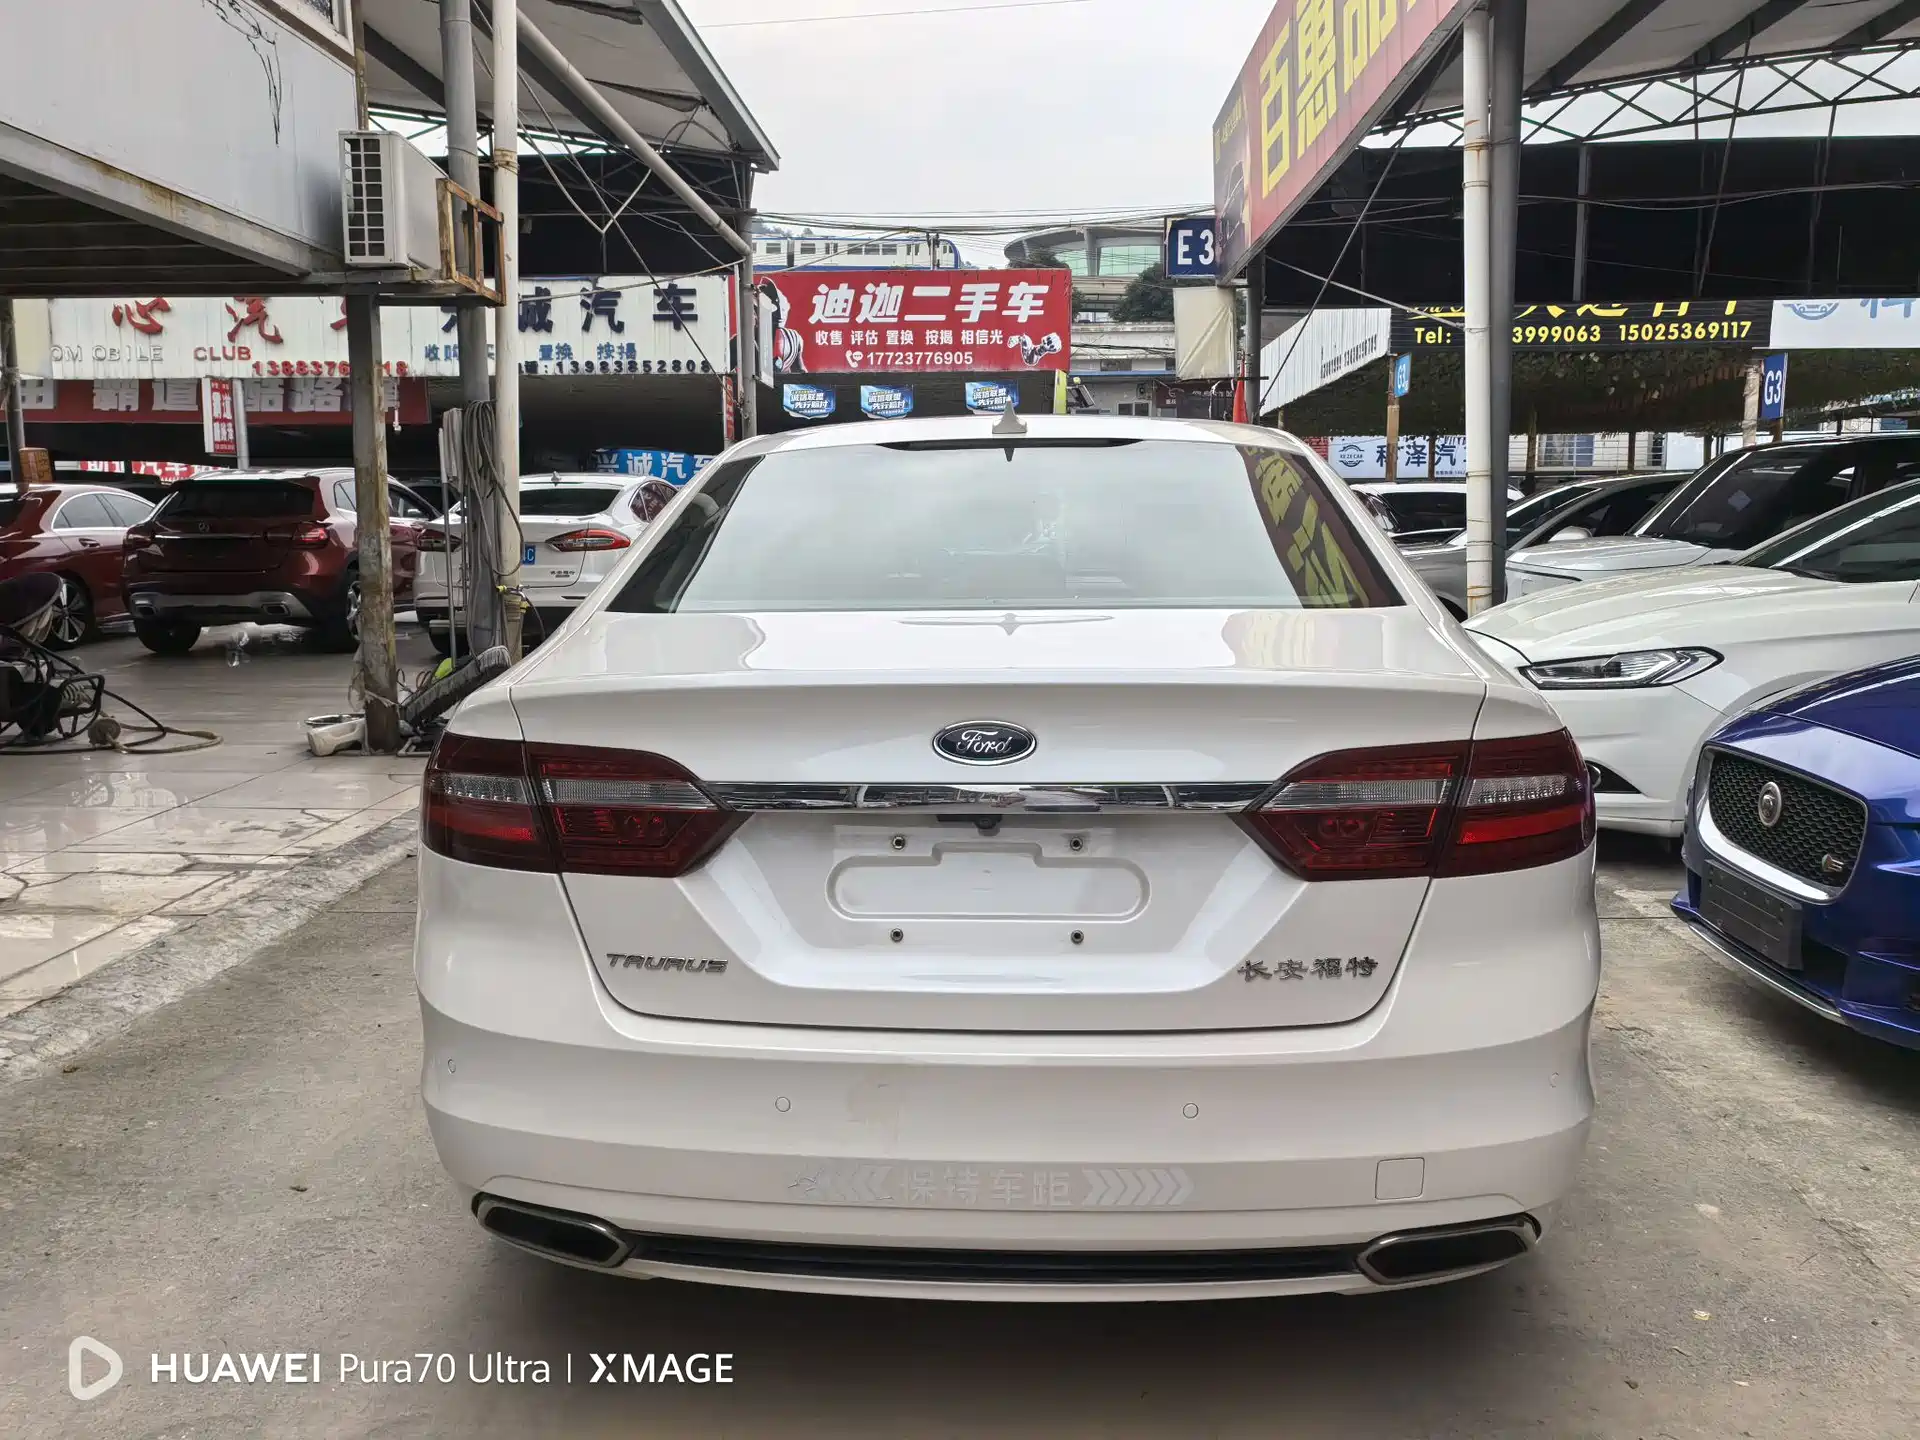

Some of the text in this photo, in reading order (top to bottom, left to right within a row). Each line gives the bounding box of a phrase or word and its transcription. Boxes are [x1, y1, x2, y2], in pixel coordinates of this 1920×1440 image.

[1177, 229, 1215, 266] E3
[808, 281, 1049, 324] 迪迦二手车
[815, 330, 1004, 346] 收售 评估 置换 按揭 相信光
[1414, 326, 1451, 344] Tel:
[1618, 321, 1752, 342] 15025369117
[194, 346, 252, 361] CLUB
[867, 351, 974, 365] 17723776905
[1764, 370, 1783, 406] G3
[956, 730, 1013, 753] Ford
[606, 953, 729, 973] TAURUS
[1237, 956, 1379, 983] 长安福特
[905, 1166, 1073, 1208] 保持车距
